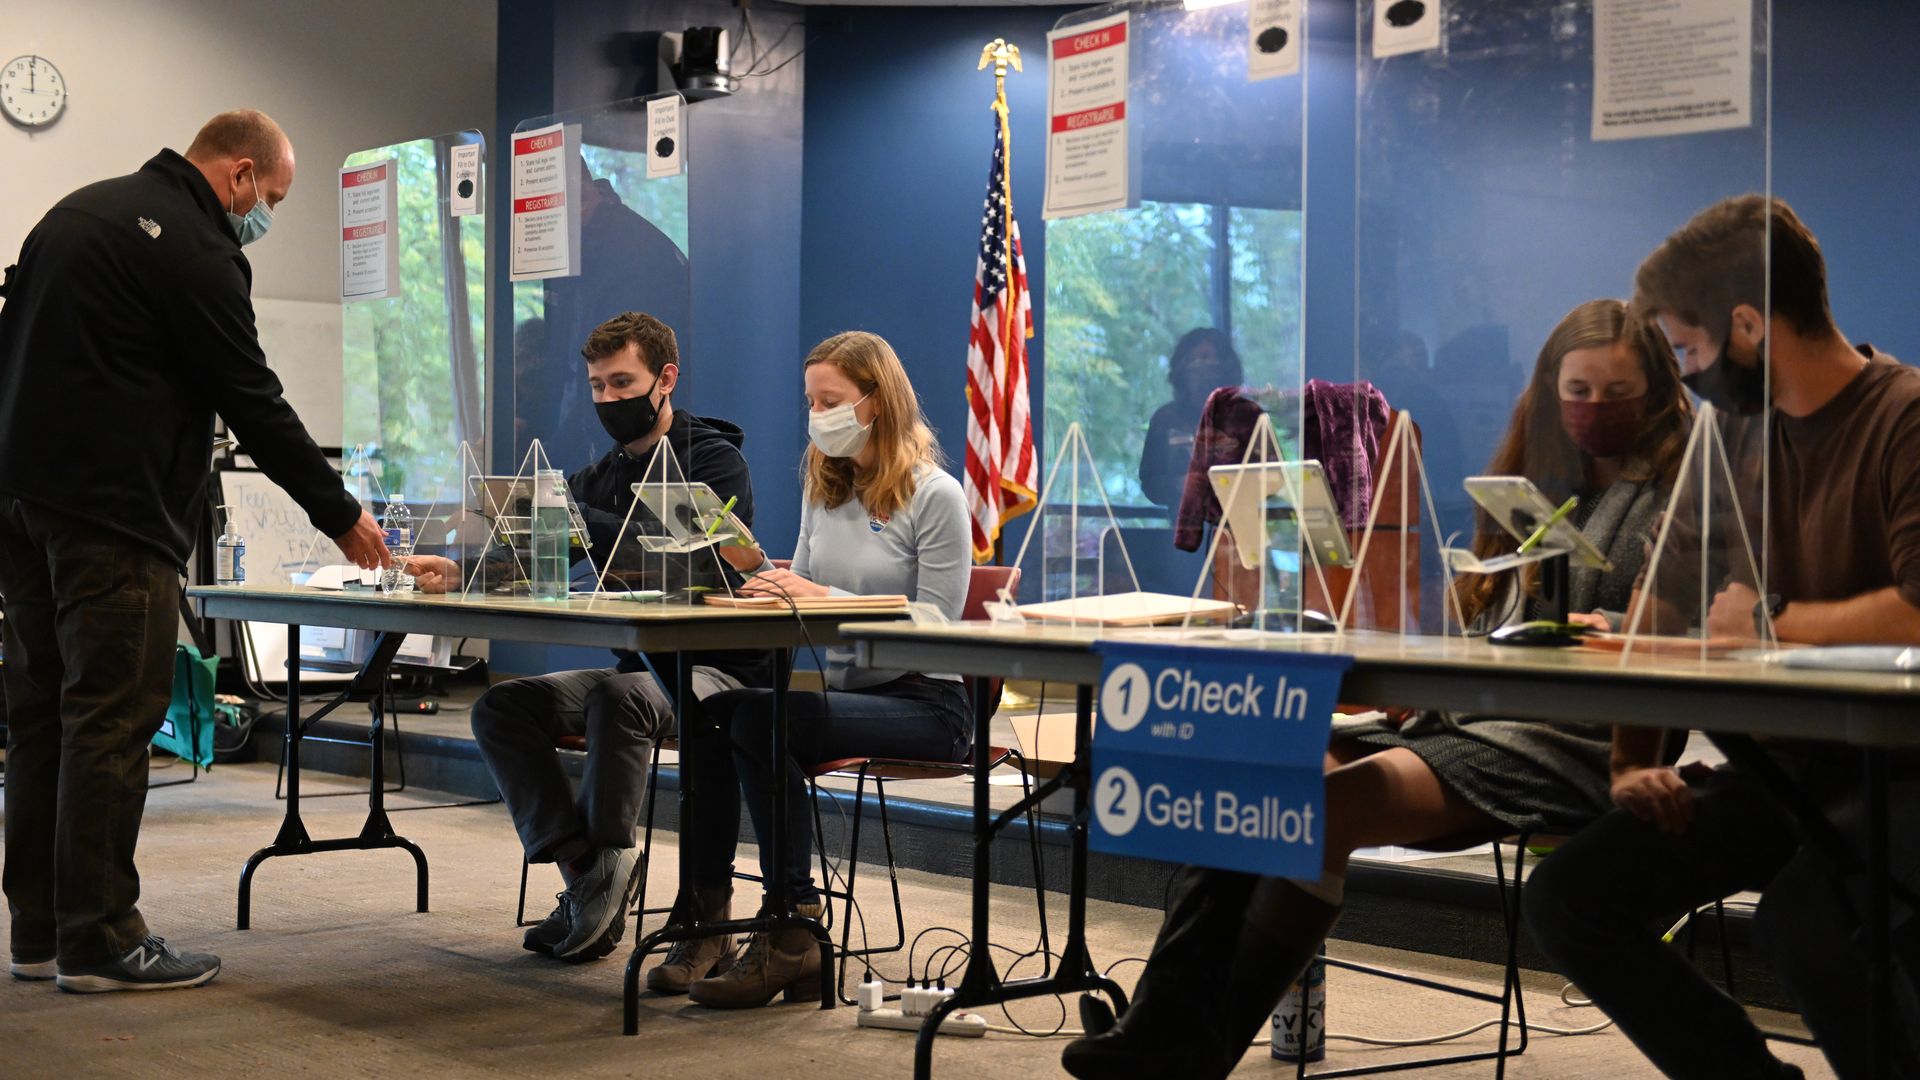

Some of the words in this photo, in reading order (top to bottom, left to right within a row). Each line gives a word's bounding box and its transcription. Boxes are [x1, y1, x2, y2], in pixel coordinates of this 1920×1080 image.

[1073, 33, 1100, 51] CHECK
[1101, 31, 1110, 44] IN
[530, 137, 547, 150] CHECK
[356, 171, 373, 183] CHECK
[1118, 677, 1133, 716] 1
[1155, 668, 1264, 717] Check
[1273, 675, 1309, 721] In
[1151, 722, 1176, 738] with
[1178, 723, 1195, 740] ID
[1108, 776, 1127, 817] 2
[1144, 783, 1204, 832] Get
[1214, 790, 1315, 846] Ballot
[123, 945, 161, 971] N
